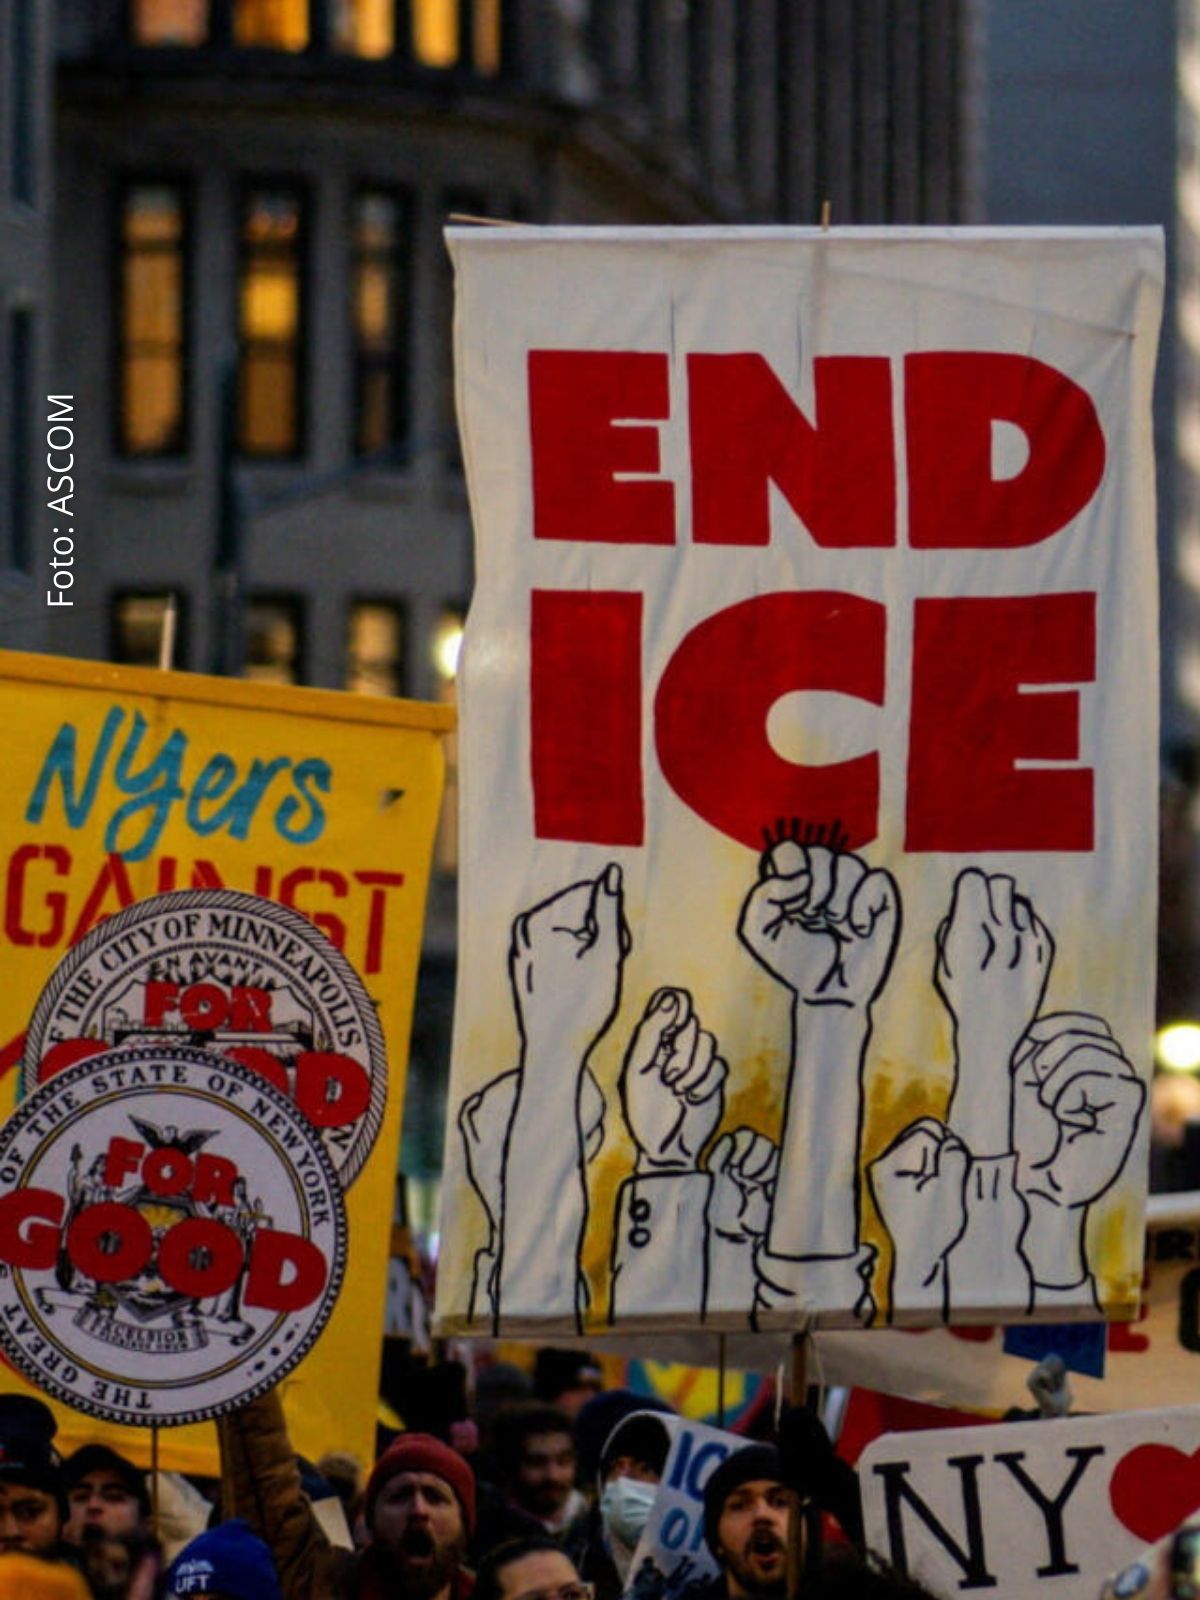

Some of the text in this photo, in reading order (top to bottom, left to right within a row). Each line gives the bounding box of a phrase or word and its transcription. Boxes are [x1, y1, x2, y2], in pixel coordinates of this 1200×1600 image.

[528, 349, 1106, 550] END
[529, 588, 1098, 854] ICE
[57, 969, 103, 1023] THE
[103, 922, 160, 972] CITY
[164, 912, 201, 940] OF
[208, 912, 363, 1048] MINNEAPOLIS
[144, 979, 273, 1034] FOR
[189, 952, 263, 976] AVANT
[0, 1149, 24, 1183] OF
[28, 1090, 80, 1138] THE
[92, 1064, 188, 1094] STATE
[208, 1073, 244, 1099] OF
[252, 1099, 304, 1152] NEW
[294, 1148, 331, 1227] YORK
[103, 1137, 239, 1207] FOR
[0, 1187, 328, 1313] GOOD
[3, 1303, 152, 1410] THE GREAT
[873, 1446, 1104, 1591] NY
